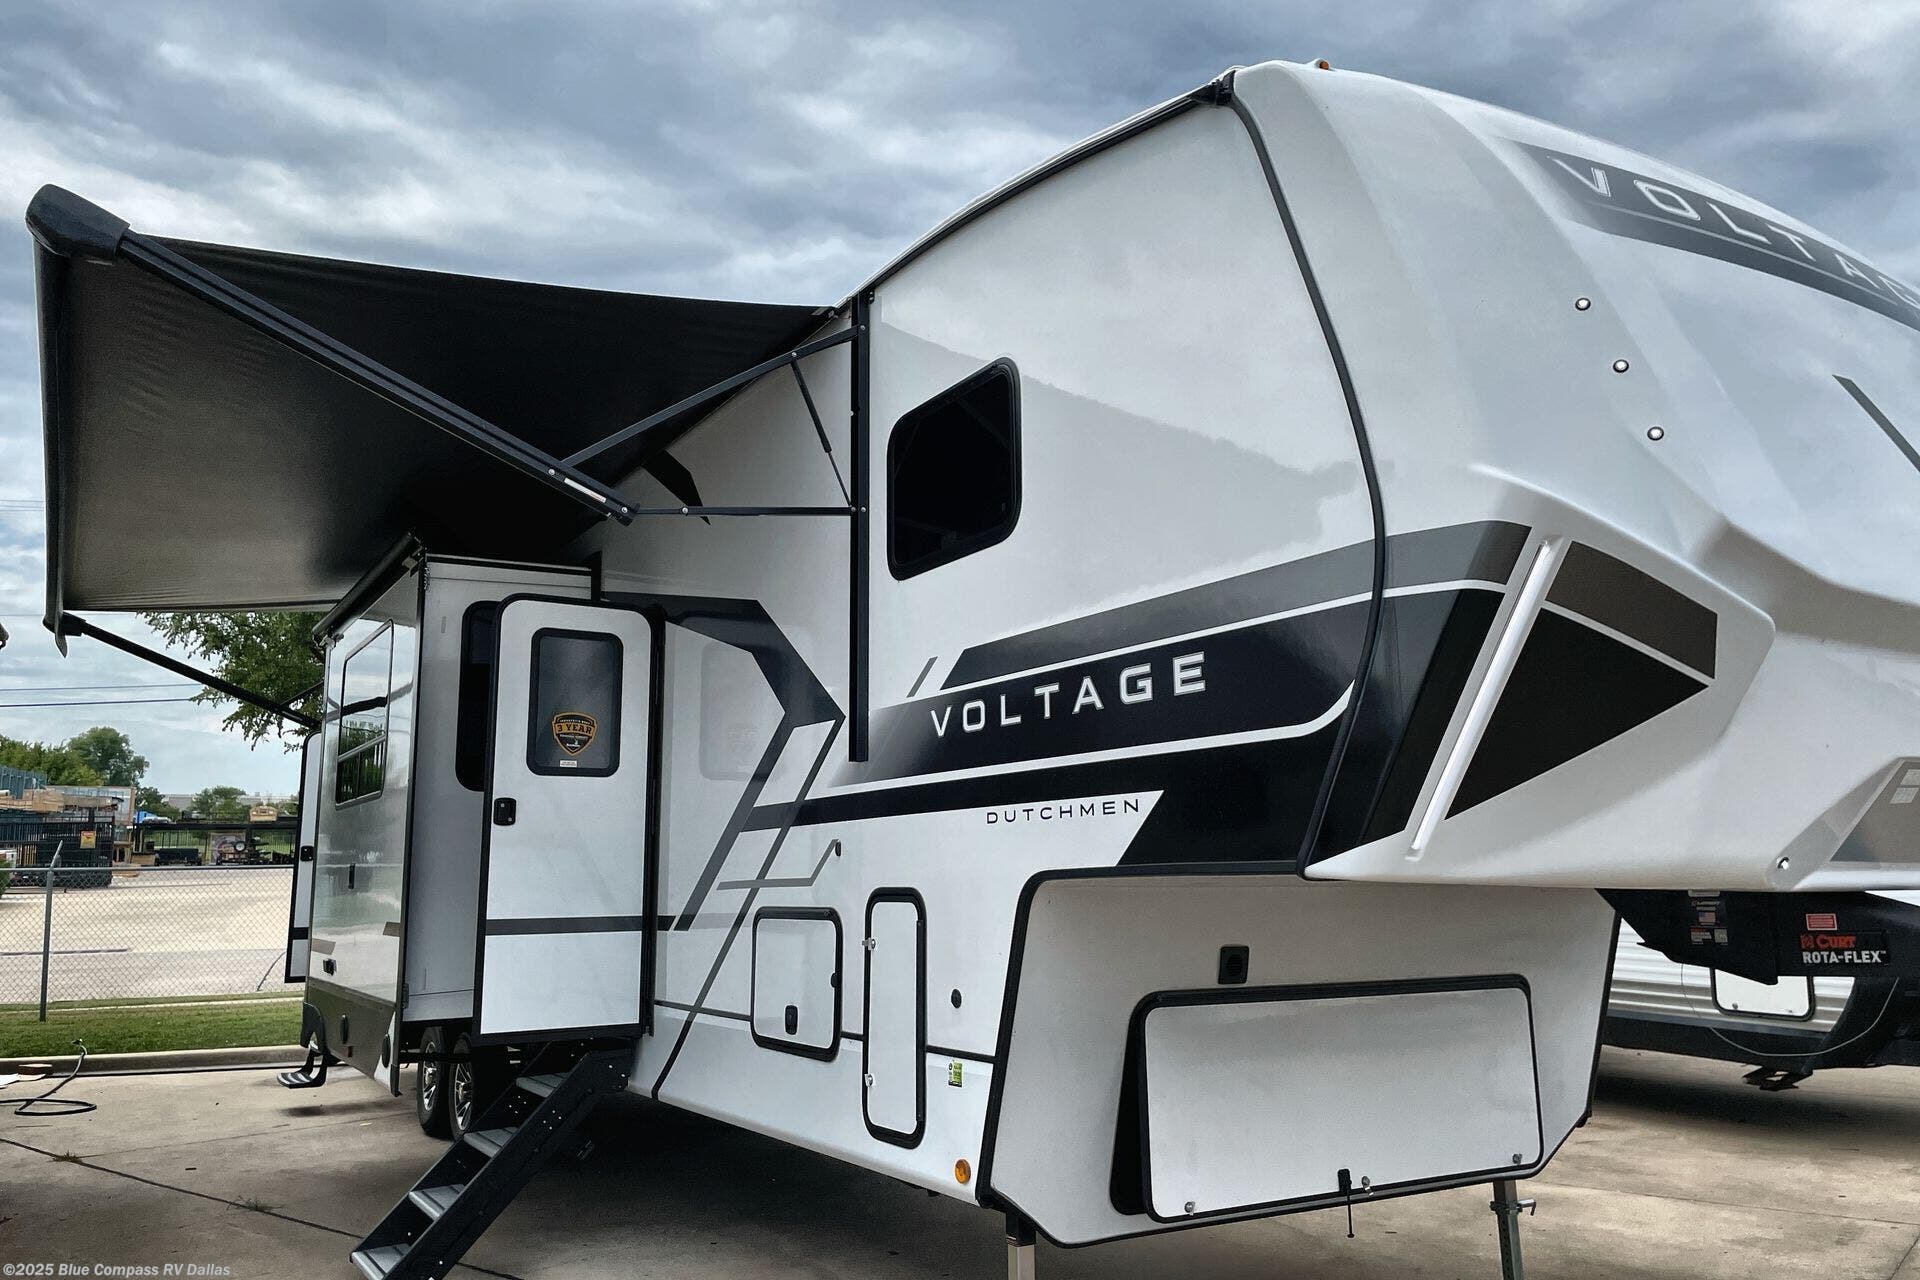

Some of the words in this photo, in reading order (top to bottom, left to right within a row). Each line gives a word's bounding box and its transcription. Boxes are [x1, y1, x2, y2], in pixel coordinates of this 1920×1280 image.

[930, 651, 1206, 738] VOLTAGE
[557, 724, 563, 732] 3
[566, 724, 592, 734] YEAR
[986, 798, 1140, 824] DUTCHMEN
